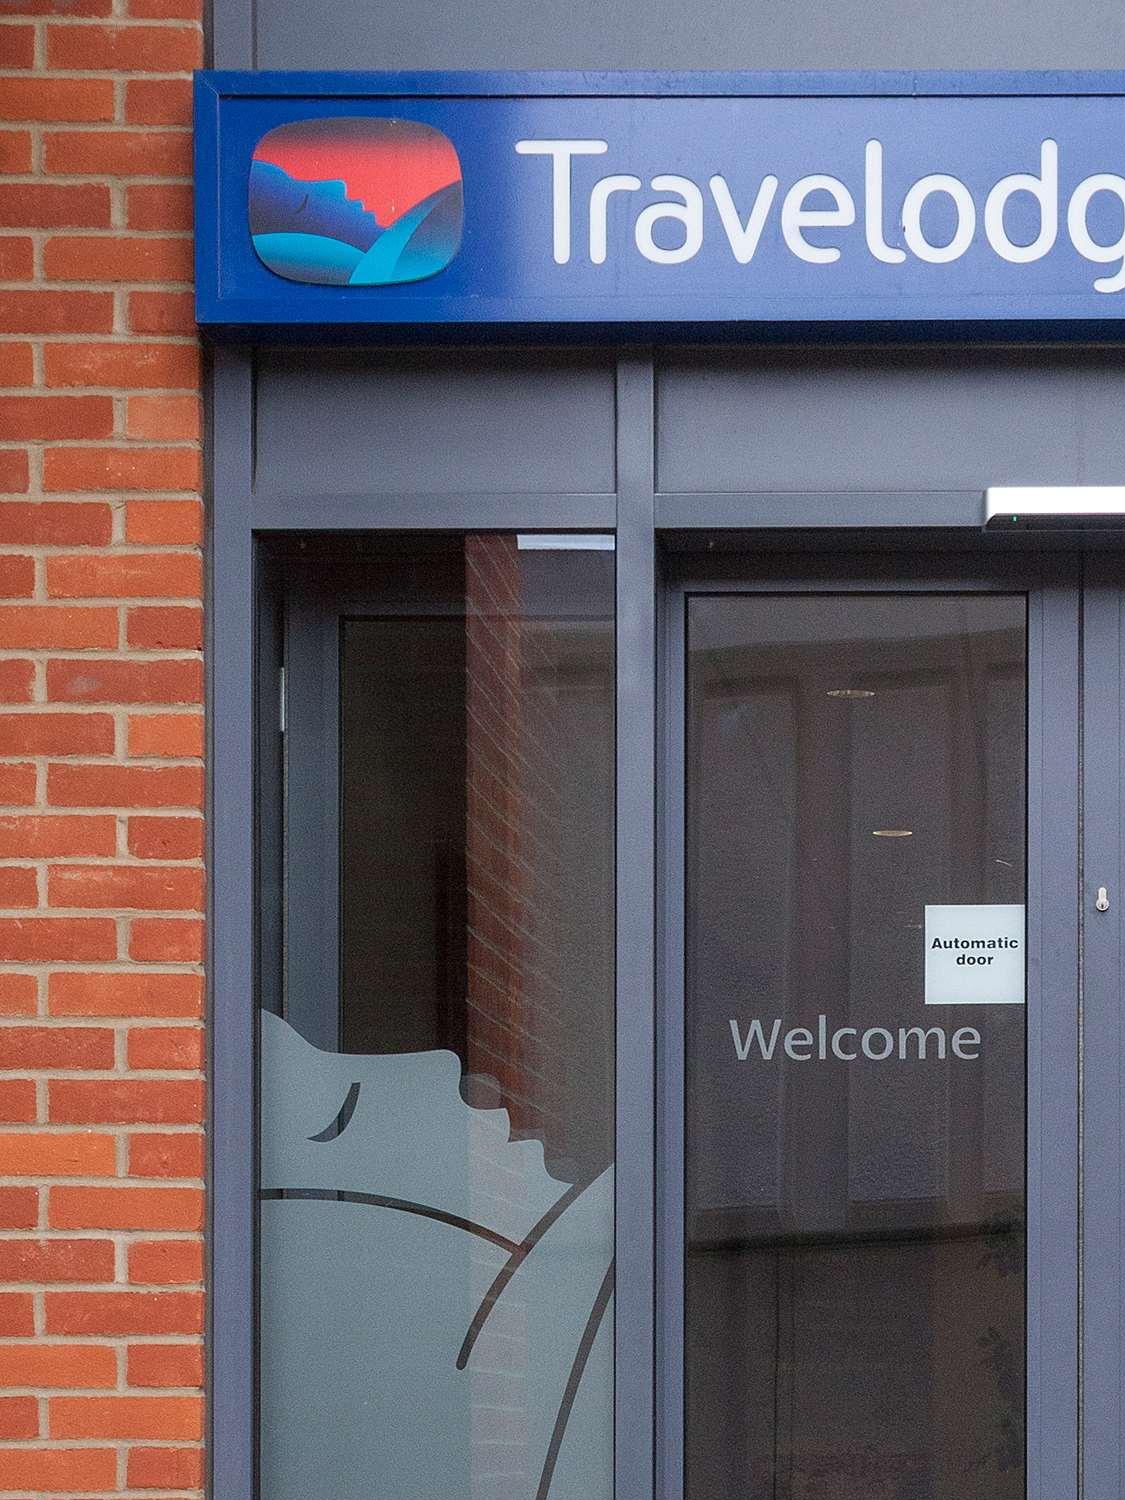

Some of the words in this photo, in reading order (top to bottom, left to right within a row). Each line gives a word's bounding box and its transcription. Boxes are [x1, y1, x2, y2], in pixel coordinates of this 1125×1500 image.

[931, 937, 1019, 951] Automatic
[956, 954, 994, 966] door
[729, 1015, 981, 1060] Welcome
